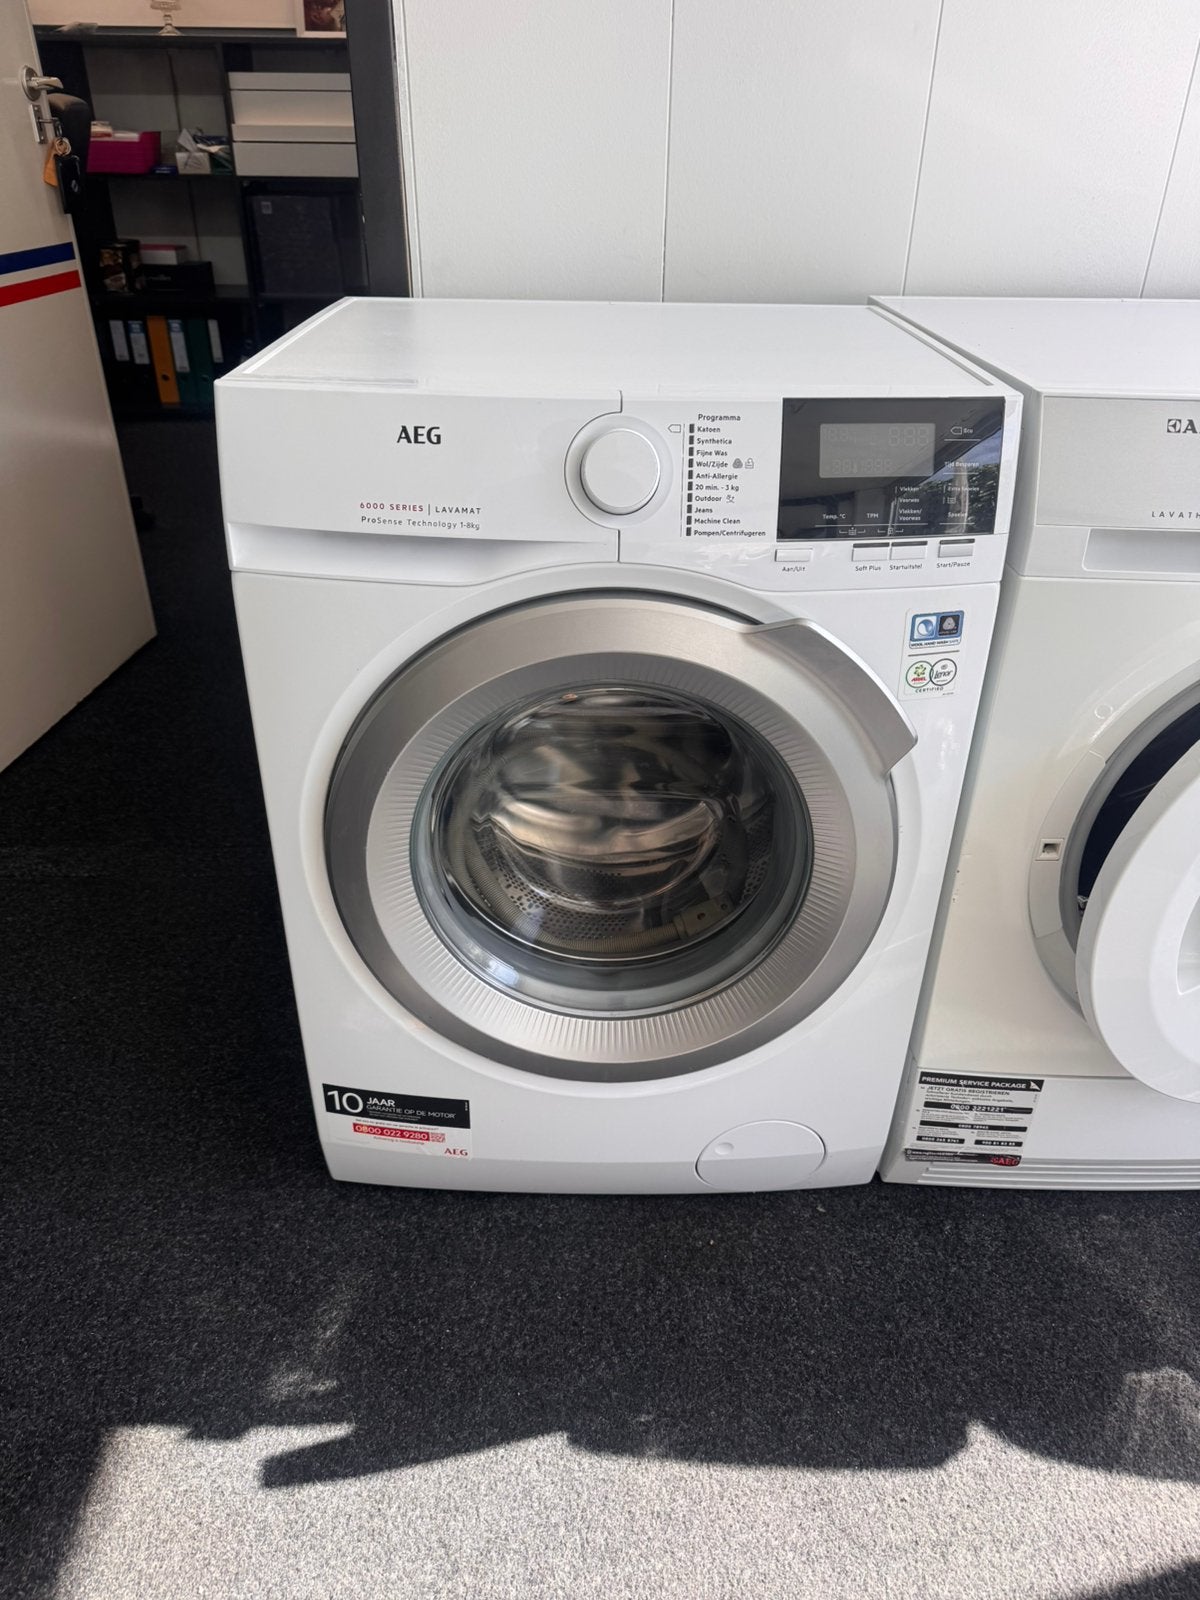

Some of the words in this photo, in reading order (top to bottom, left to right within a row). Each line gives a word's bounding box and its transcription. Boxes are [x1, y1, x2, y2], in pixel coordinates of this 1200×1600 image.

[697, 413, 741, 422] Programma
[1182, 419, 1200, 433] A
[396, 425, 442, 445] AEG
[697, 437, 733, 445] Synthetica
[696, 449, 713, 457] Fijne
[696, 460, 728, 469] Wol/Zijde
[695, 472, 739, 480] Anti-Allergie
[730, 484, 740, 492] kg
[359, 502, 385, 510] 6000
[389, 503, 424, 512] SERIES
[435, 505, 481, 515] LAVAMAT
[694, 506, 713, 514] Jeans
[361, 515, 403, 526] ProSense
[407, 518, 457, 530] Technology
[460, 521, 481, 531] 1-8kg
[693, 517, 721, 525] Machine
[722, 517, 741, 525] Clean
[693, 529, 767, 538] Pompen/Centrifugeren
[855, 564, 869, 572] Soft
[869, 564, 882, 572] Plus
[936, 560, 971, 569] Start/Pauze
[933, 669, 954, 680] Lenor
[921, 1076, 958, 1085] PREMIUM
[958, 1079, 989, 1088] SERVICE
[991, 1081, 1027, 1089] PACKAGE
[327, 1090, 364, 1114] 10
[366, 1097, 396, 1108] JAAR
[366, 1104, 403, 1114] GARANTIE
[404, 1108, 416, 1116] OP
[950, 1103, 970, 1111] 0800
[355, 1124, 382, 1135] 0800
[383, 1127, 402, 1137] 022
[403, 1130, 429, 1141] 9280
[444, 1147, 469, 1156] AEG
